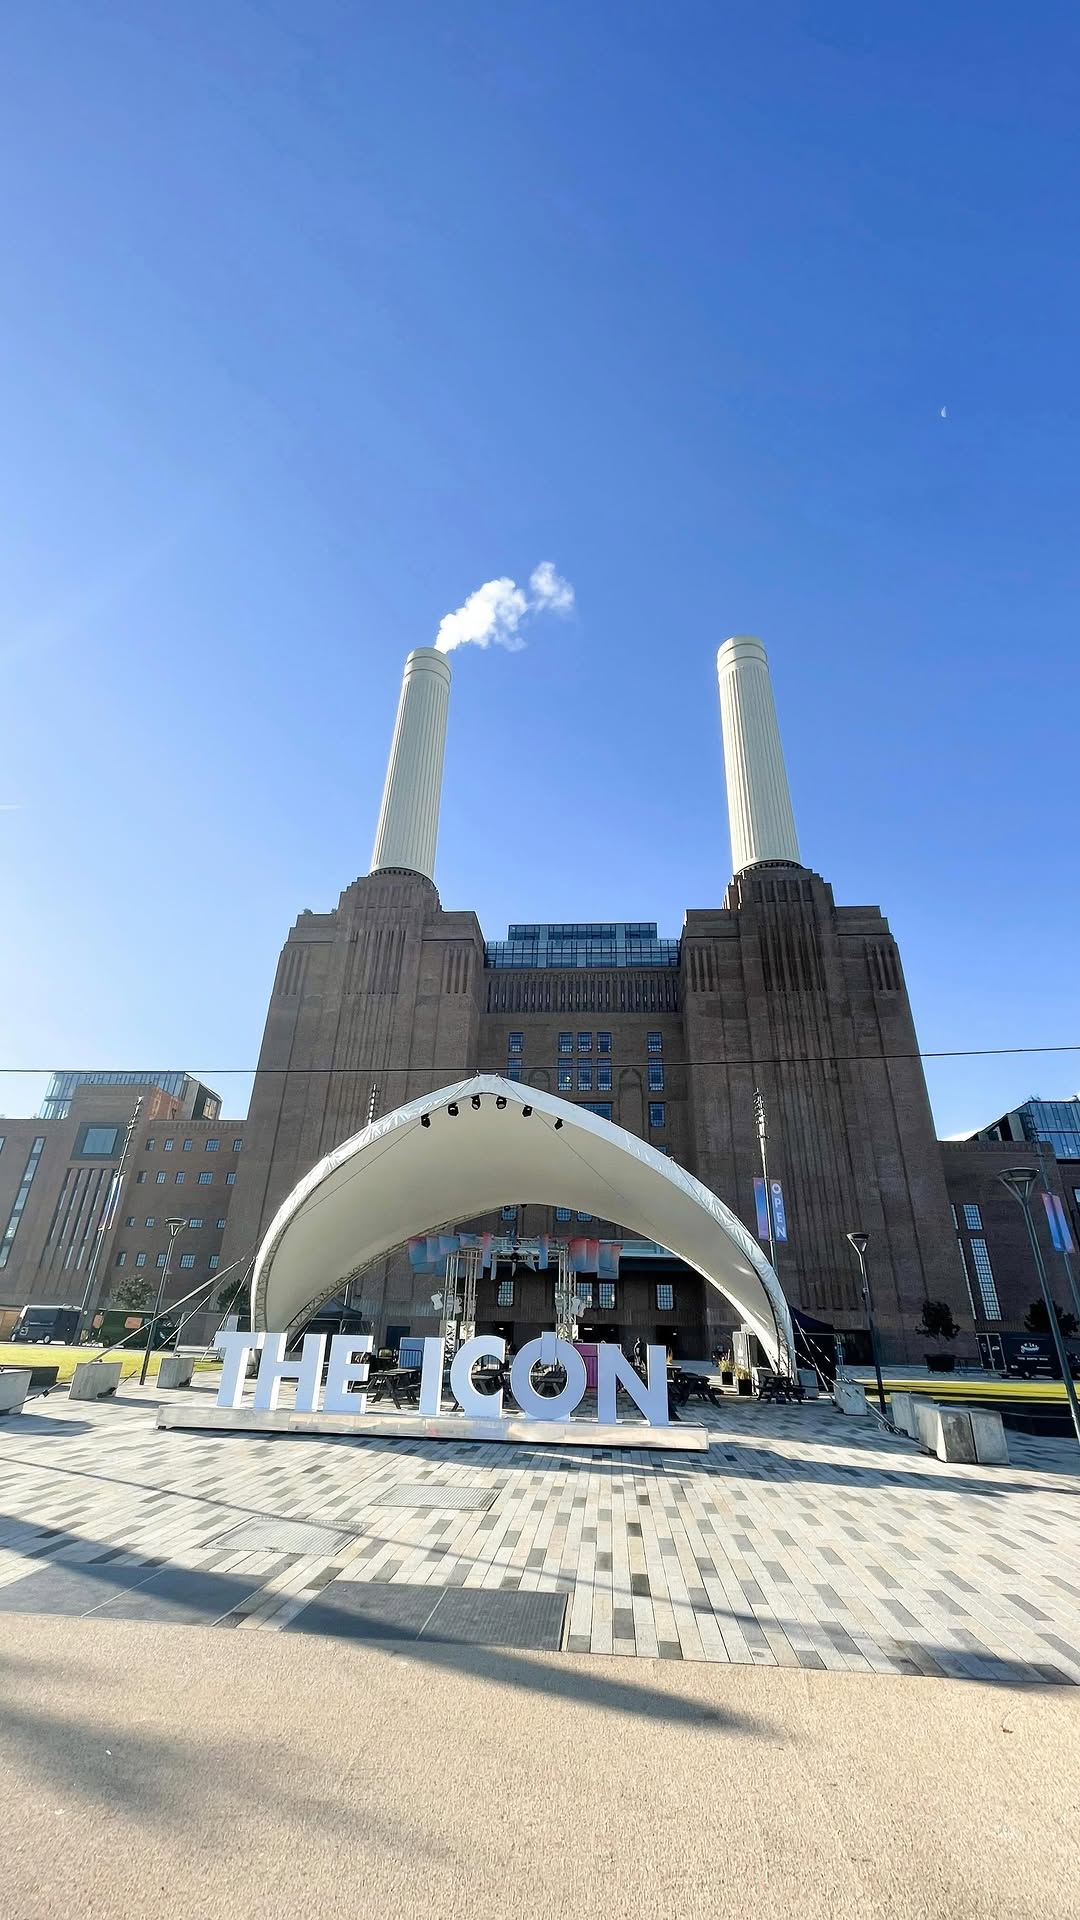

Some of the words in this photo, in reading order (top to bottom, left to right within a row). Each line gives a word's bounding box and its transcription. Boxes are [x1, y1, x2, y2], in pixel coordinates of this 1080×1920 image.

[772, 1183, 786, 1238] OPEN
[214, 1332, 373, 1414] THE
[419, 1332, 669, 1427] ICON
